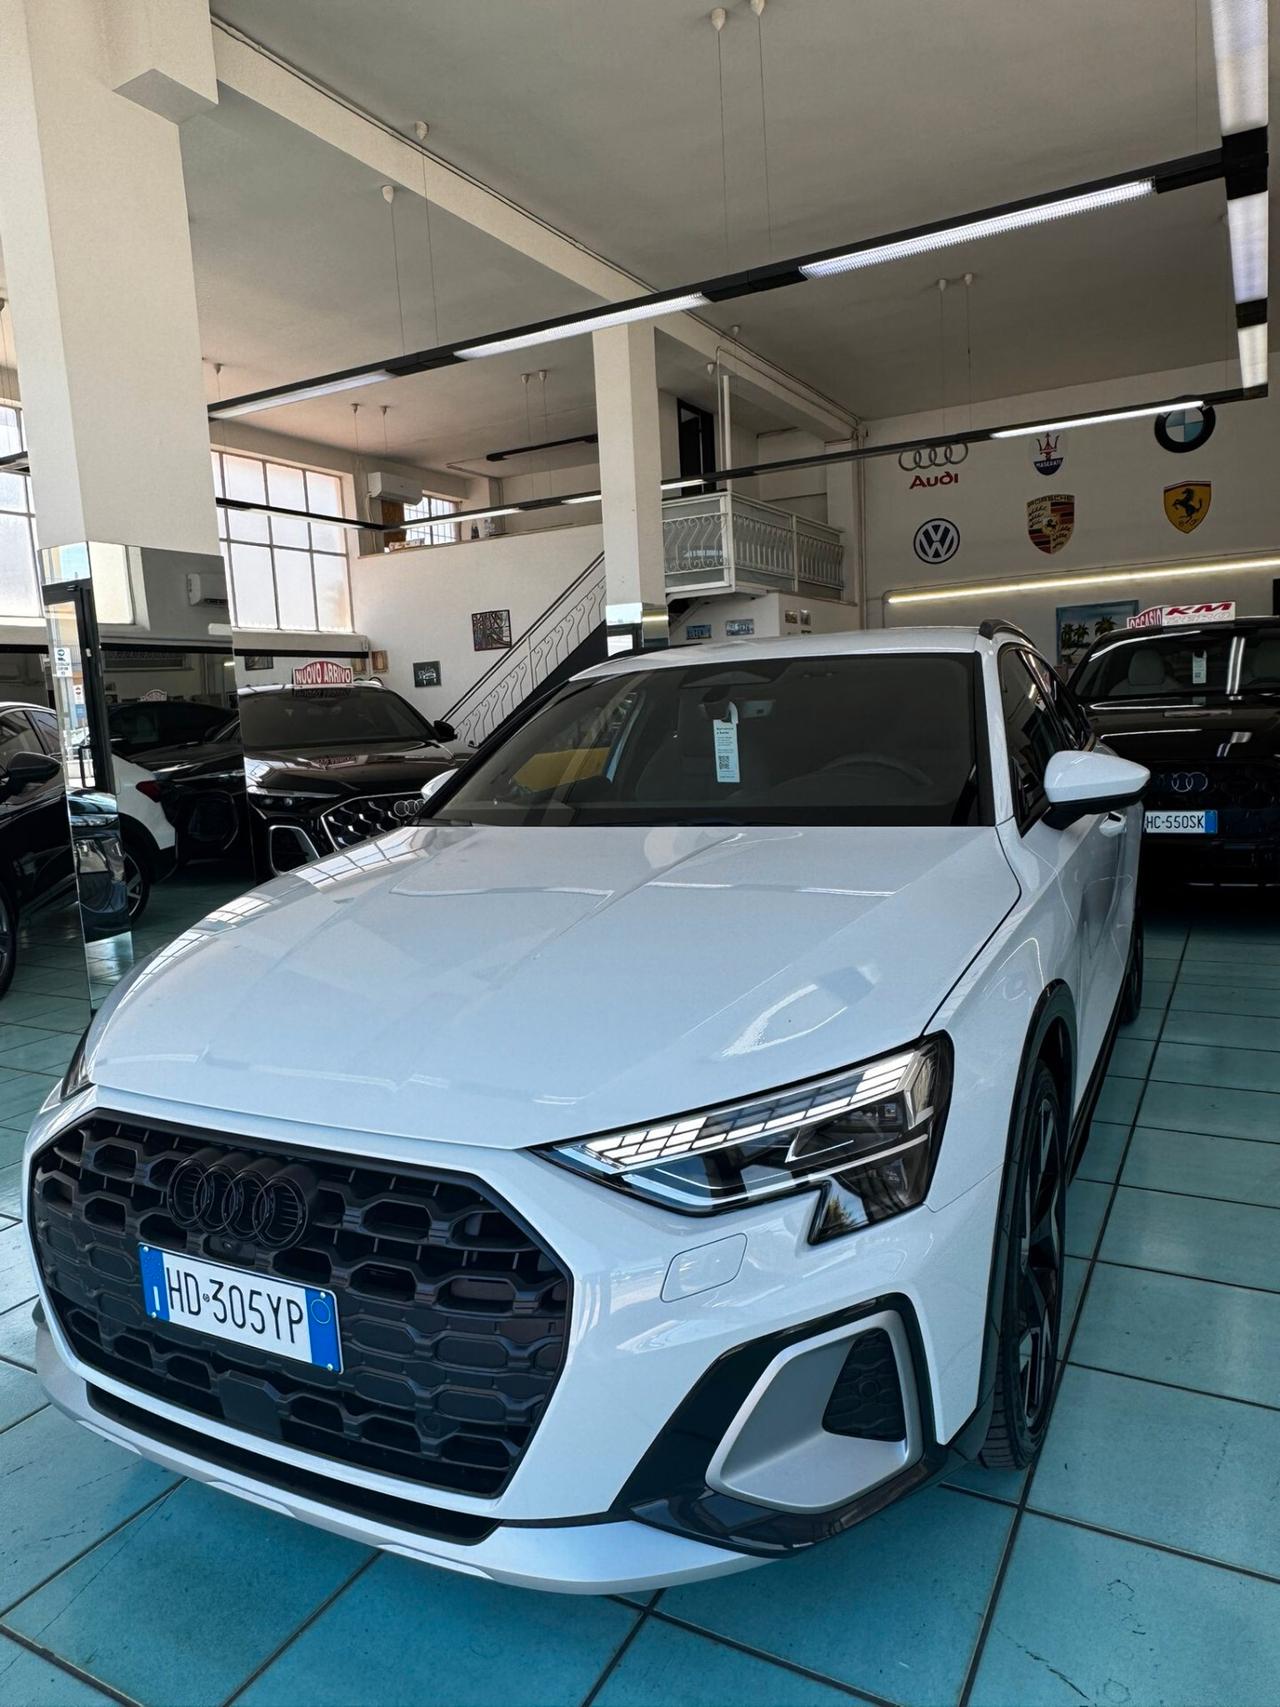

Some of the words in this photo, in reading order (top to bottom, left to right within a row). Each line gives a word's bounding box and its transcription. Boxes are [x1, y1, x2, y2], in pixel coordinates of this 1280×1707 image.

[1130, 609, 1162, 628] OCCASIO
[1165, 602, 1232, 616] KM
[295, 662, 321, 684] NUOVO
[324, 662, 351, 684] ARRIVO
